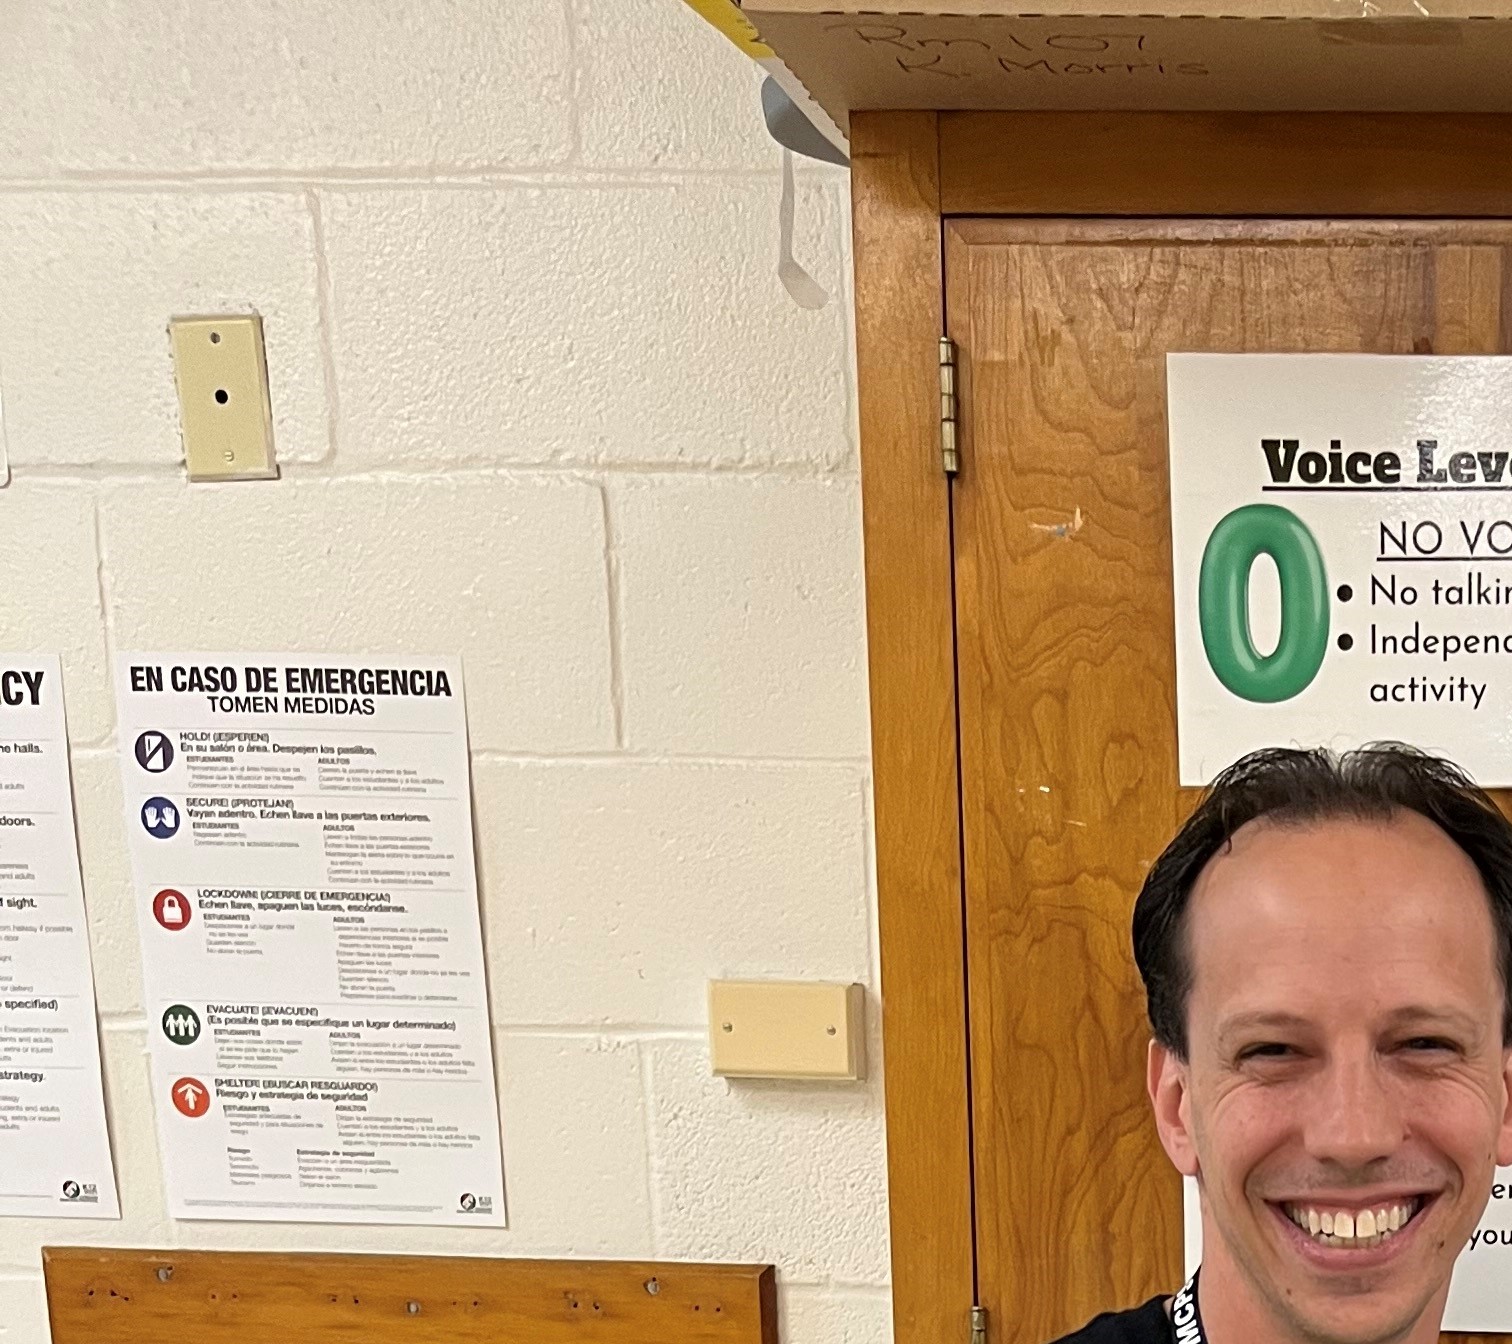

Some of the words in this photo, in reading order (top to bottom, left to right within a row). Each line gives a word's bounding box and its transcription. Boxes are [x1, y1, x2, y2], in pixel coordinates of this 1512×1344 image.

[1260, 438, 1401, 484] Voice
[1378, 519, 1443, 556] NO
[1198, 502, 1332, 705] 0
[1370, 575, 1419, 607] No
[0, 671, 44, 706] CY
[130, 666, 163, 692] EN
[171, 666, 237, 693] CASO
[246, 667, 278, 693] DE
[286, 668, 452, 697] EMERGENCIA
[1369, 675, 1487, 710] activity
[207, 696, 278, 713] TOMEN
[285, 697, 375, 716] MEDIDAS
